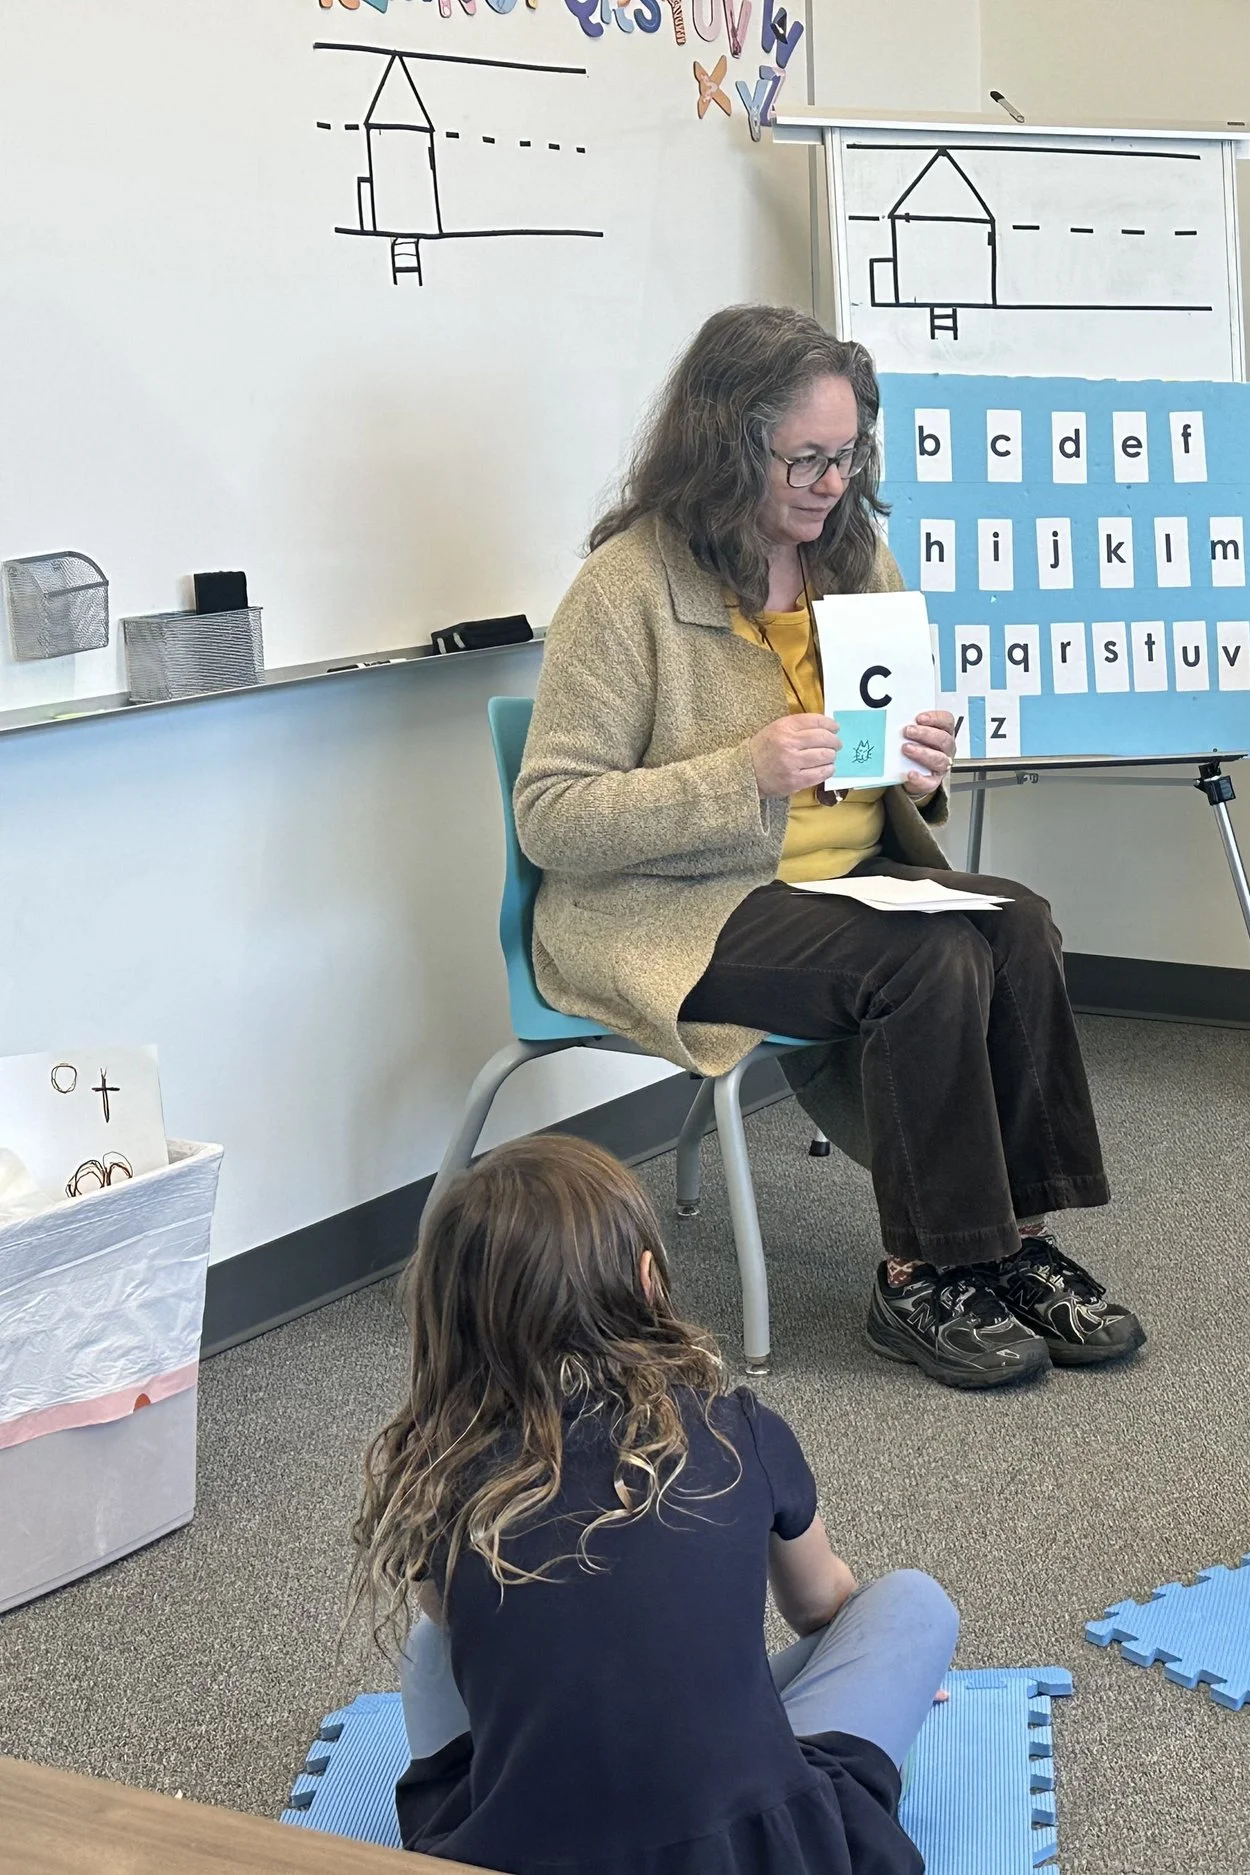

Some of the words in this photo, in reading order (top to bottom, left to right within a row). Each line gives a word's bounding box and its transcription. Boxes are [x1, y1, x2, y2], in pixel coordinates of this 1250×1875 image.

[918, 425, 941, 457] b
[990, 434, 1011, 457] c
[1059, 428, 1081, 459] d
[1121, 435, 1143, 458] e
[1181, 423, 1192, 454] f
[925, 532, 945, 563] h
[992, 531, 1000, 562] i
[1050, 530, 1060, 569] j
[1106, 533, 1126, 564] k
[1210, 539, 1239, 560] m
[961, 643, 983, 673] p
[1007, 643, 1029, 673] q
[1060, 641, 1071, 664] r
[1104, 640, 1119, 663] s
[1144, 633, 1156, 662] t
[1182, 645, 1200, 668] u
[1221, 645, 1241, 667] v
[990, 717, 1007, 739] z
